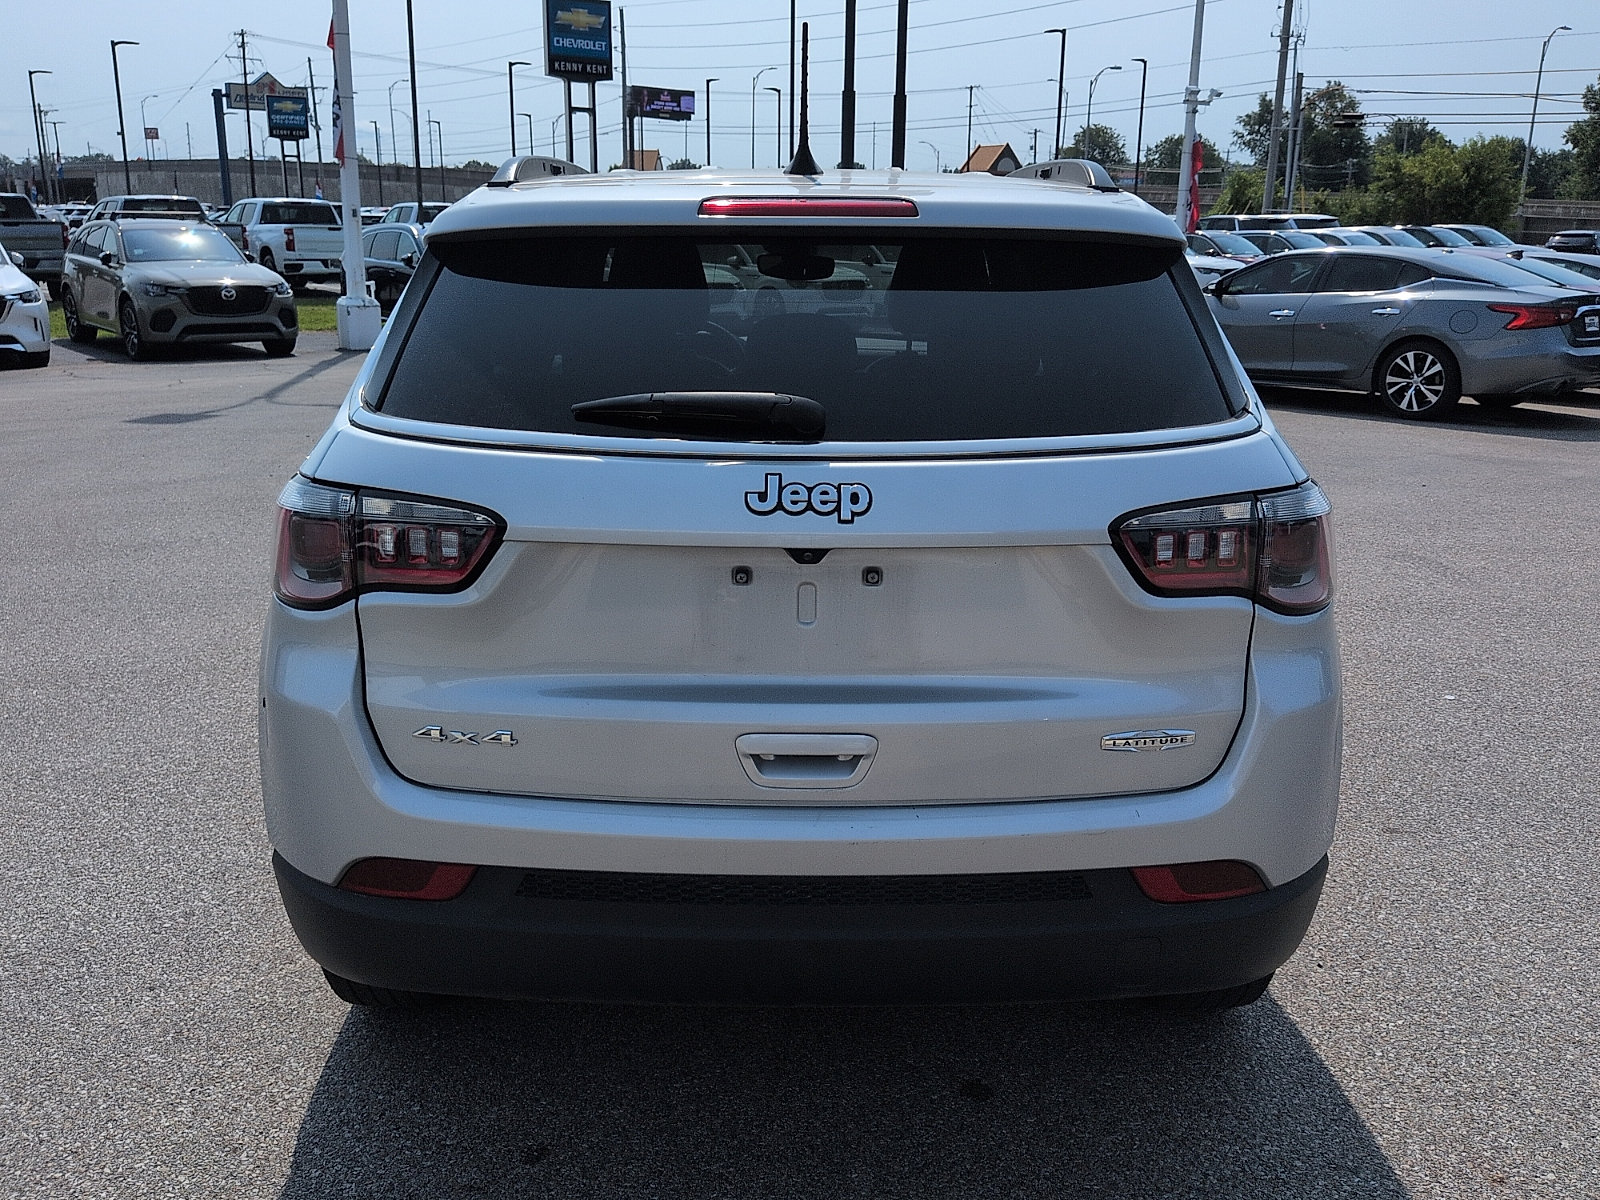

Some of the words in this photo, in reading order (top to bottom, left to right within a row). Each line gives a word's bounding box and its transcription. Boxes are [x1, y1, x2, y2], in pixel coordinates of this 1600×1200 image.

[553, 37, 607, 51] CHEVROLET
[554, 61, 583, 72] KENNY
[586, 64, 608, 75] KENT
[744, 472, 873, 524] Jeep
[411, 724, 519, 747] 4x4
[1112, 736, 1188, 748] LATITUDE
